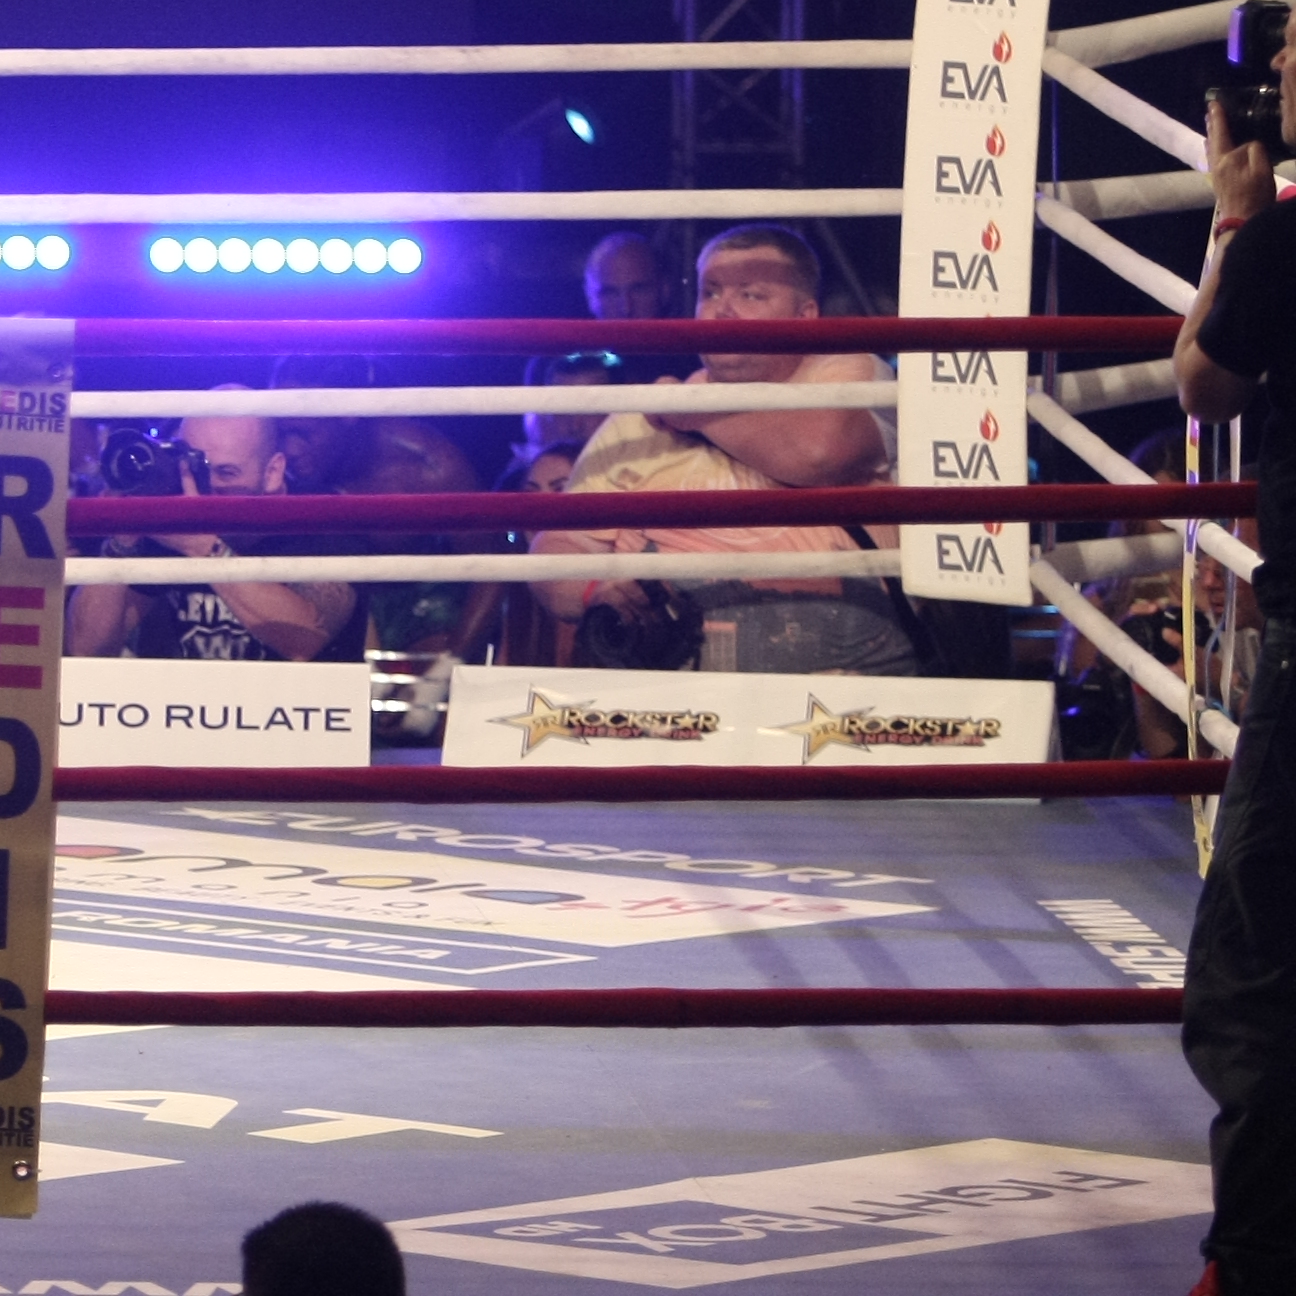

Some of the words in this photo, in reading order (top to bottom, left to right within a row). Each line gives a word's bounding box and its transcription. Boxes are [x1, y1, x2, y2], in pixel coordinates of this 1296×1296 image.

[941, 61, 1008, 103] EVA
[936, 156, 1004, 197] EVA
[932, 251, 1000, 292] EVA
[932, 441, 1001, 481] EVA
[936, 534, 1005, 574] EVA
[58, 704, 149, 729] UTO
[165, 704, 353, 732] RULATE
[161, 807, 935, 888] EUROSPORT
[55, 910, 452, 961] ROMANIA
[809, 1170, 1149, 1224] FIGHT
[493, 1220, 605, 1239] HD
[572, 1213, 844, 1253] BOX
